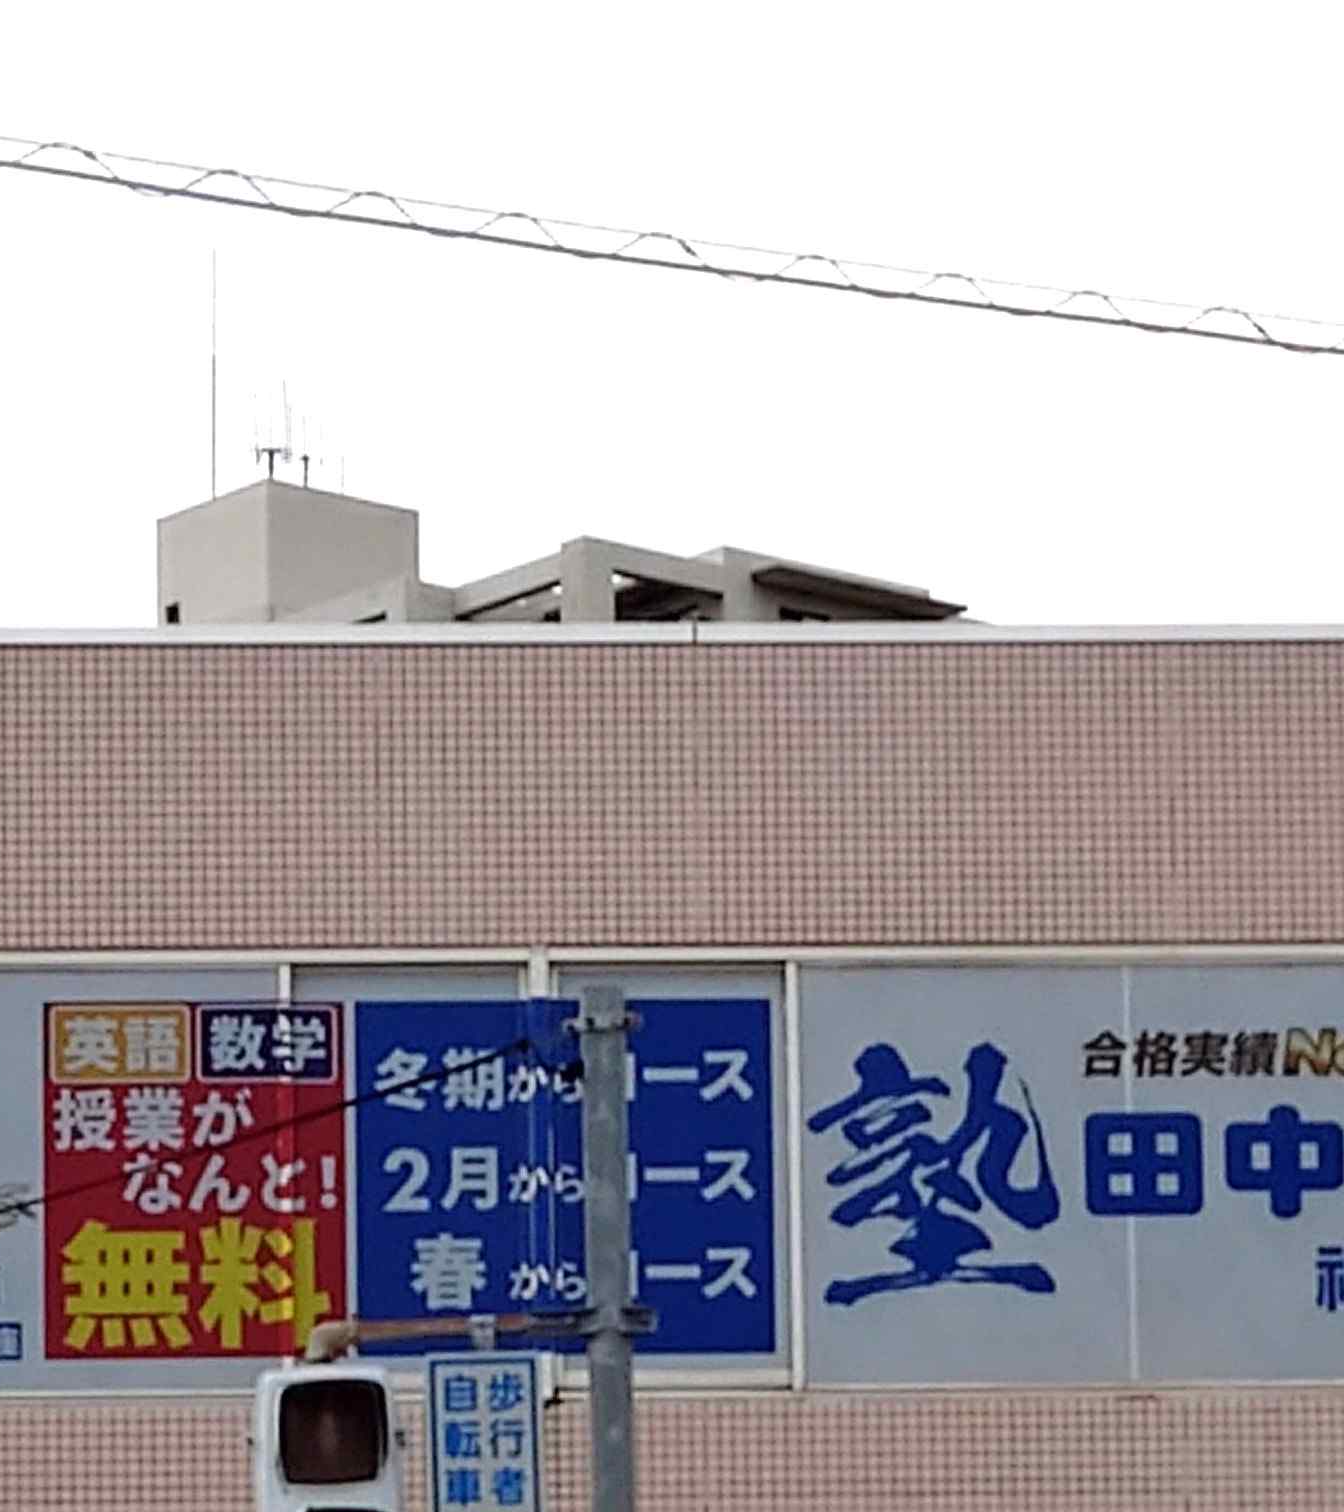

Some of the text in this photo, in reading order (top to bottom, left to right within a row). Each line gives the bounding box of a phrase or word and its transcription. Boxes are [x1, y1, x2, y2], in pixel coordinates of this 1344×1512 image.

[64, 1016, 328, 1073] 英語 数学
[54, 1087, 251, 1152] 授業が
[122, 1155, 339, 1215] なんと!
[382, 1146, 756, 1213] 2月からース
[806, 1042, 1061, 1305] 塾
[63, 1219, 329, 1351] 無料
[410, 1232, 758, 1311] 春からース
[444, 1374, 480, 1507] 自転車
[489, 1373, 527, 1506] 歩行者
